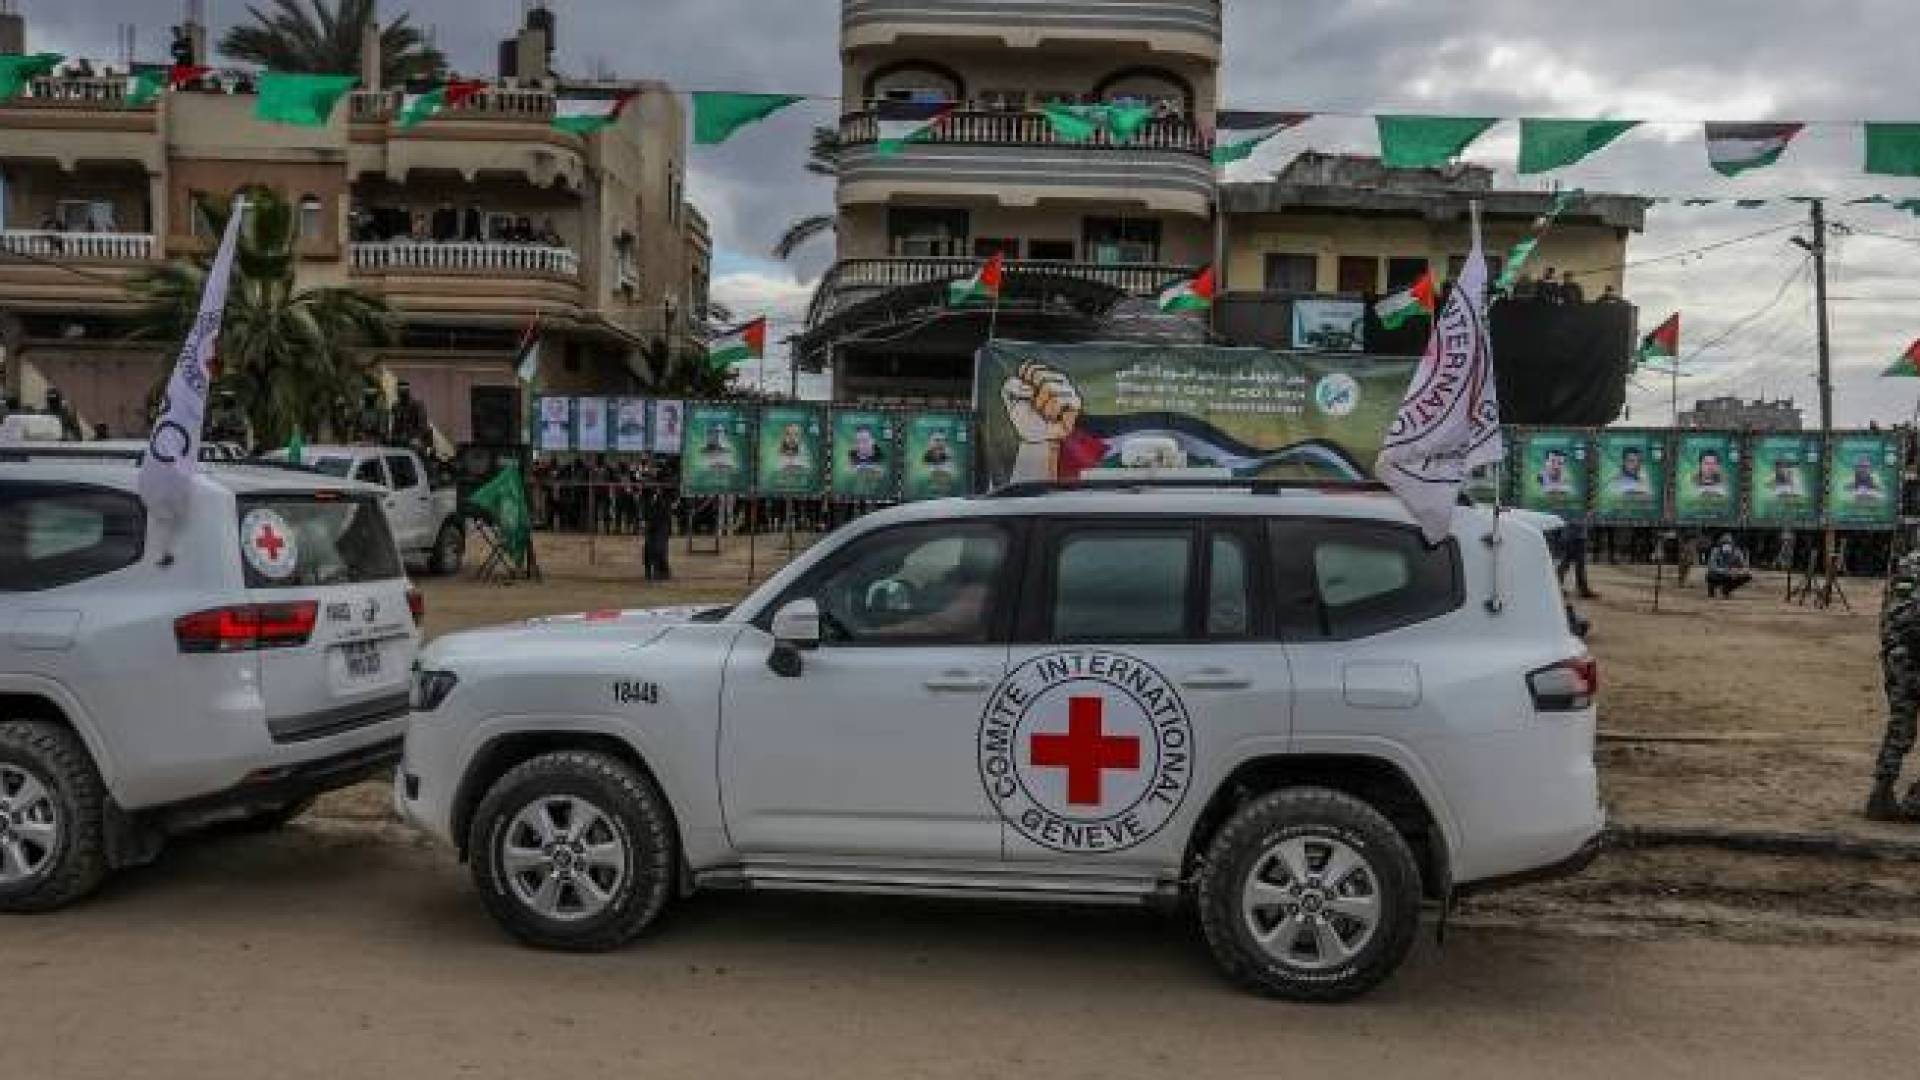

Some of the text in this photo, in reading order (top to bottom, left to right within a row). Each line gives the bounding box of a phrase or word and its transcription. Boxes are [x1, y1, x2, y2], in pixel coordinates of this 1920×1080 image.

[986, 655, 1185, 804] COMITE INTERNATIONAL
[1021, 808, 1144, 848] GENEVE
